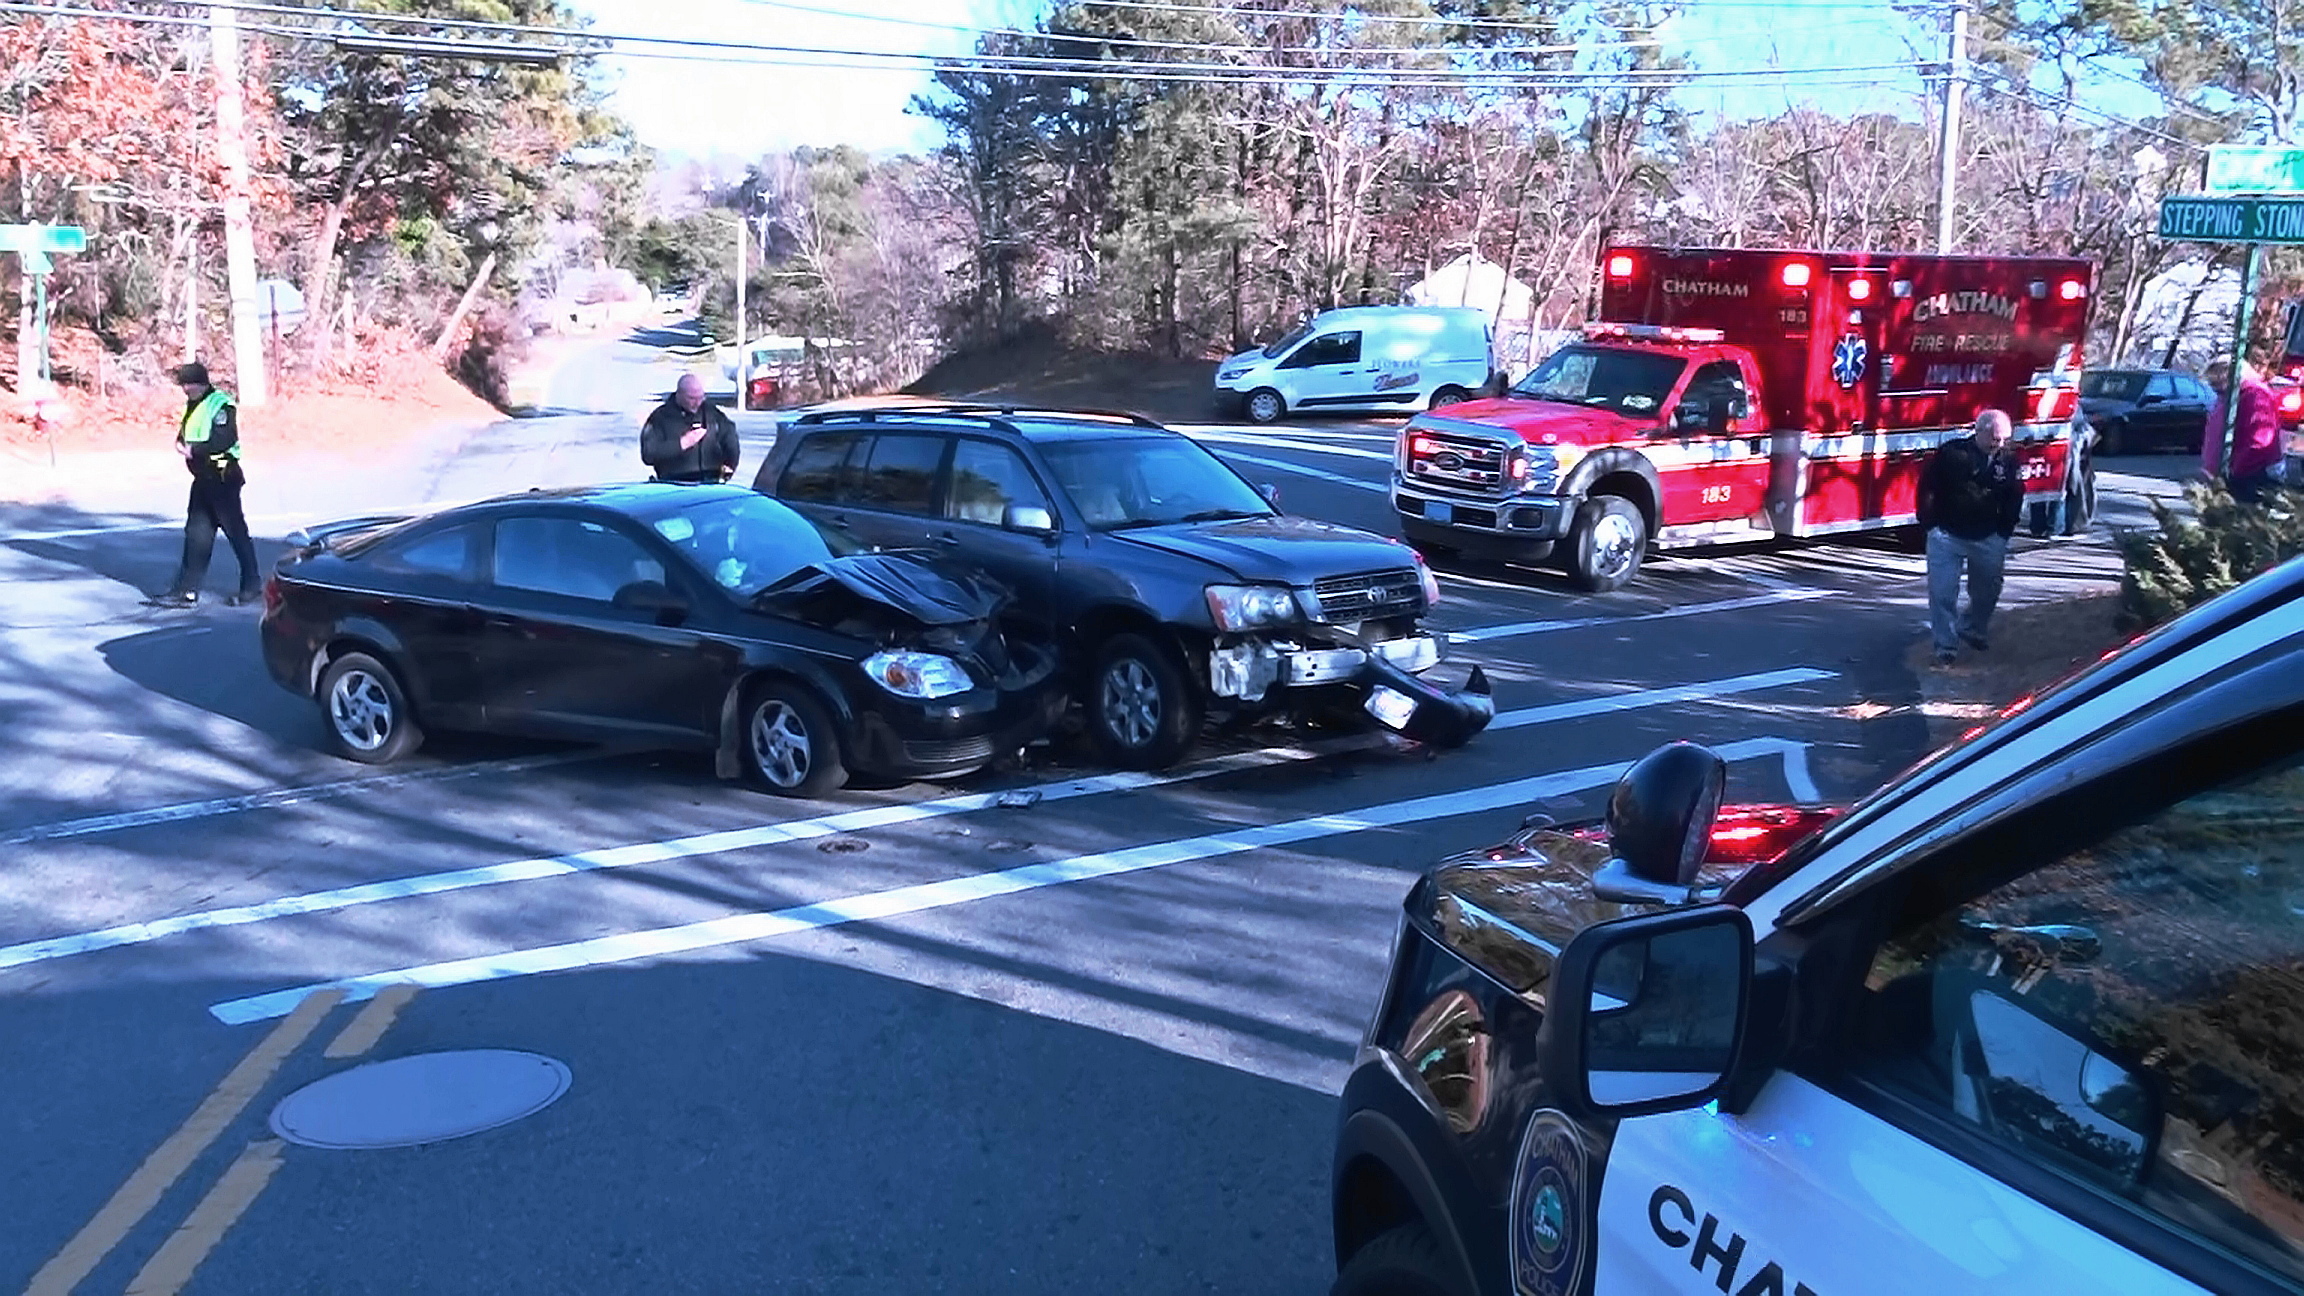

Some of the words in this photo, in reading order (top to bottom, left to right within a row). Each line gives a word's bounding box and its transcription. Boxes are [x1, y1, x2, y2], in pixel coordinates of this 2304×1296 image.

[2162, 203, 2244, 236] STEPPING
[2254, 203, 2304, 238] STON
[1662, 279, 1749, 297] CHATHAM
[1779, 308, 1807, 323] 183
[1913, 291, 2019, 322] CHATHAM
[1910, 334, 1944, 352] FIRE
[1701, 485, 1731, 504] 183
[1648, 1184, 1818, 1296] CHA
